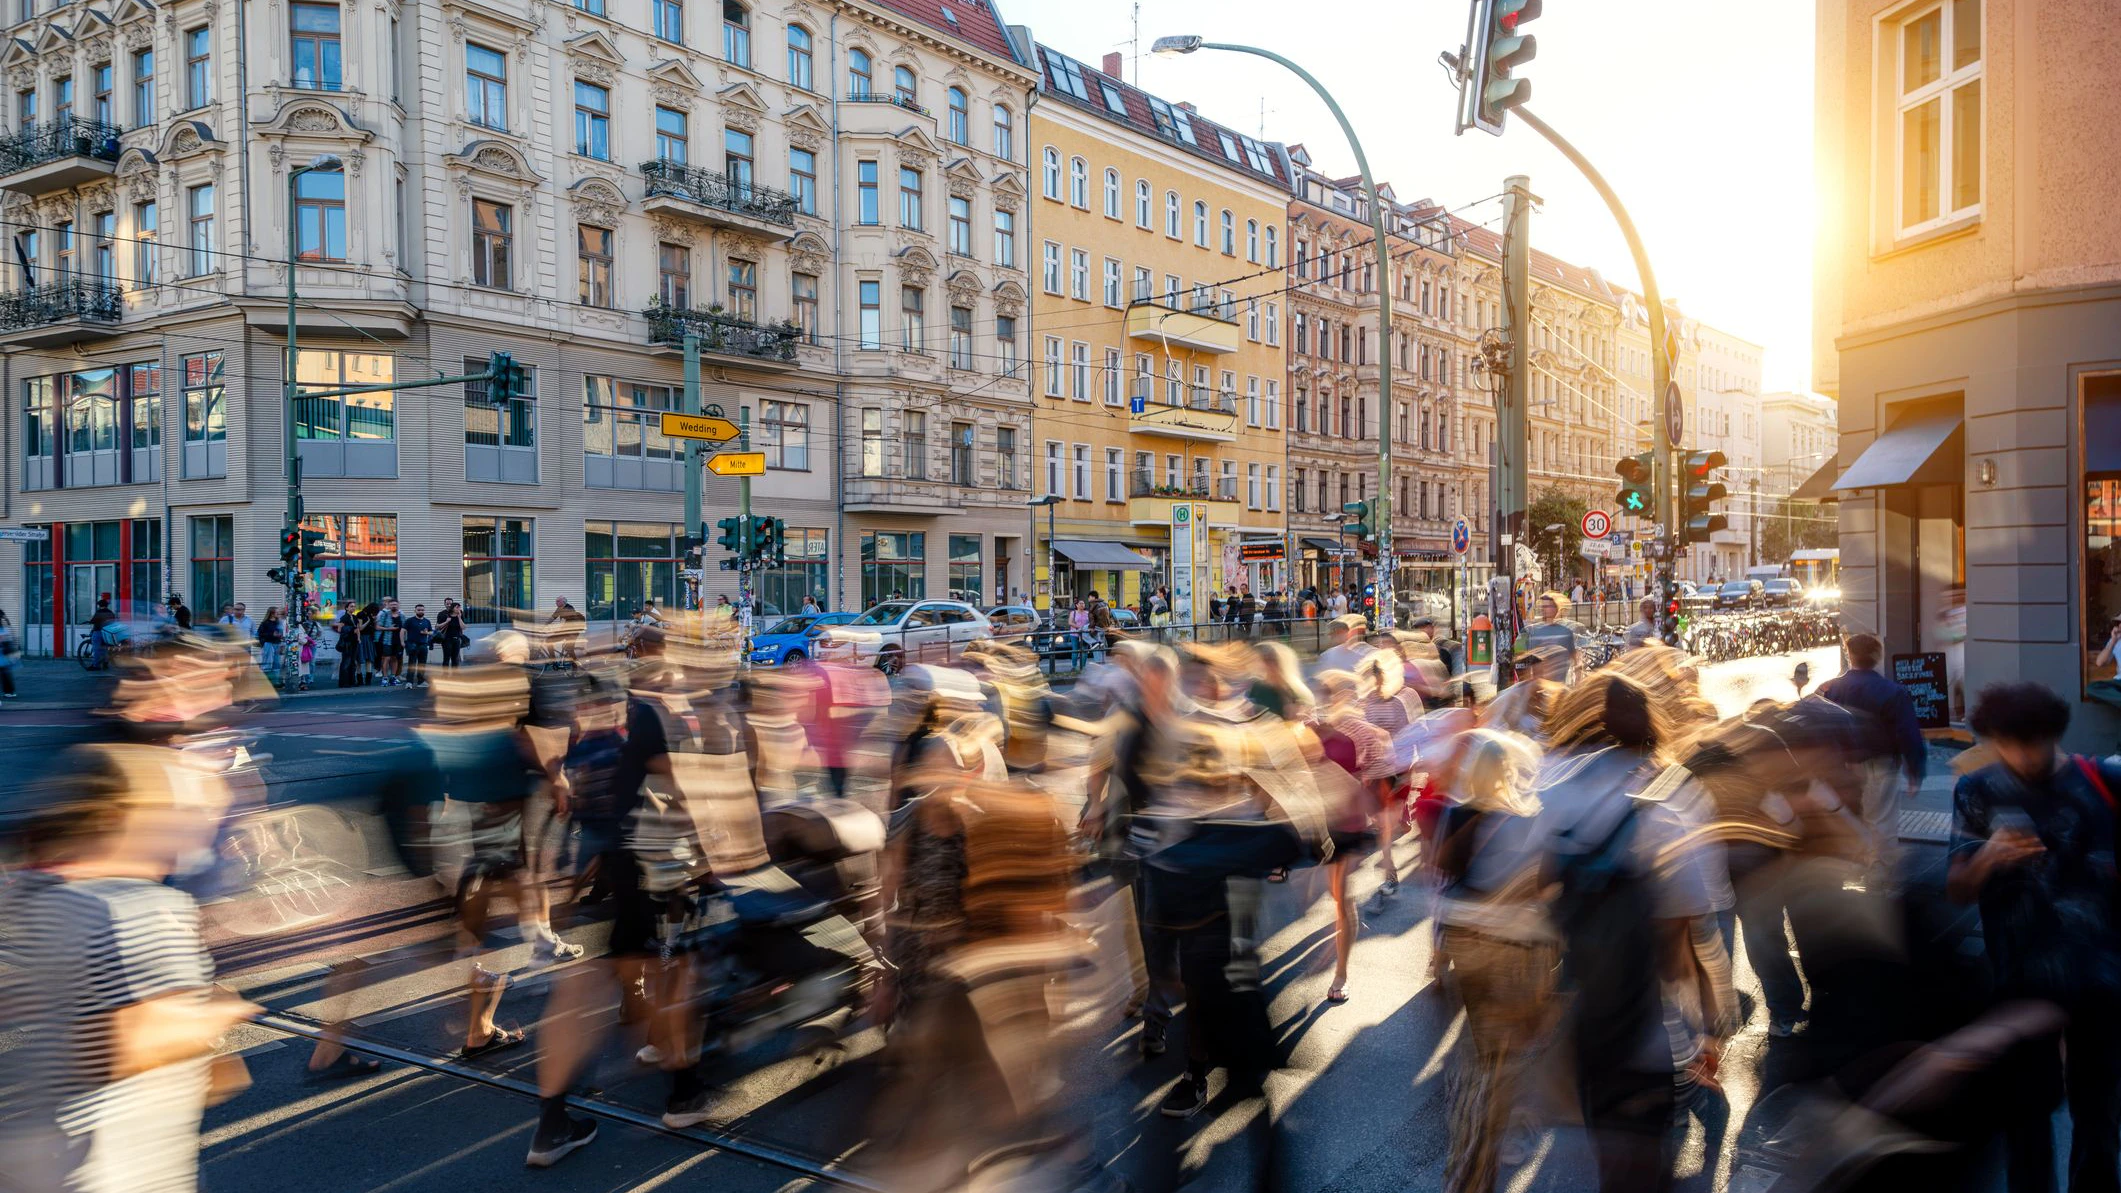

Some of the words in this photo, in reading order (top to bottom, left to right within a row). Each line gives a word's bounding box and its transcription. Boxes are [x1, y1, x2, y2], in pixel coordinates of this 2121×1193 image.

[680, 421, 717, 435] Wedding
[729, 460, 746, 469] Mitte
[1588, 518, 1605, 531] 30
